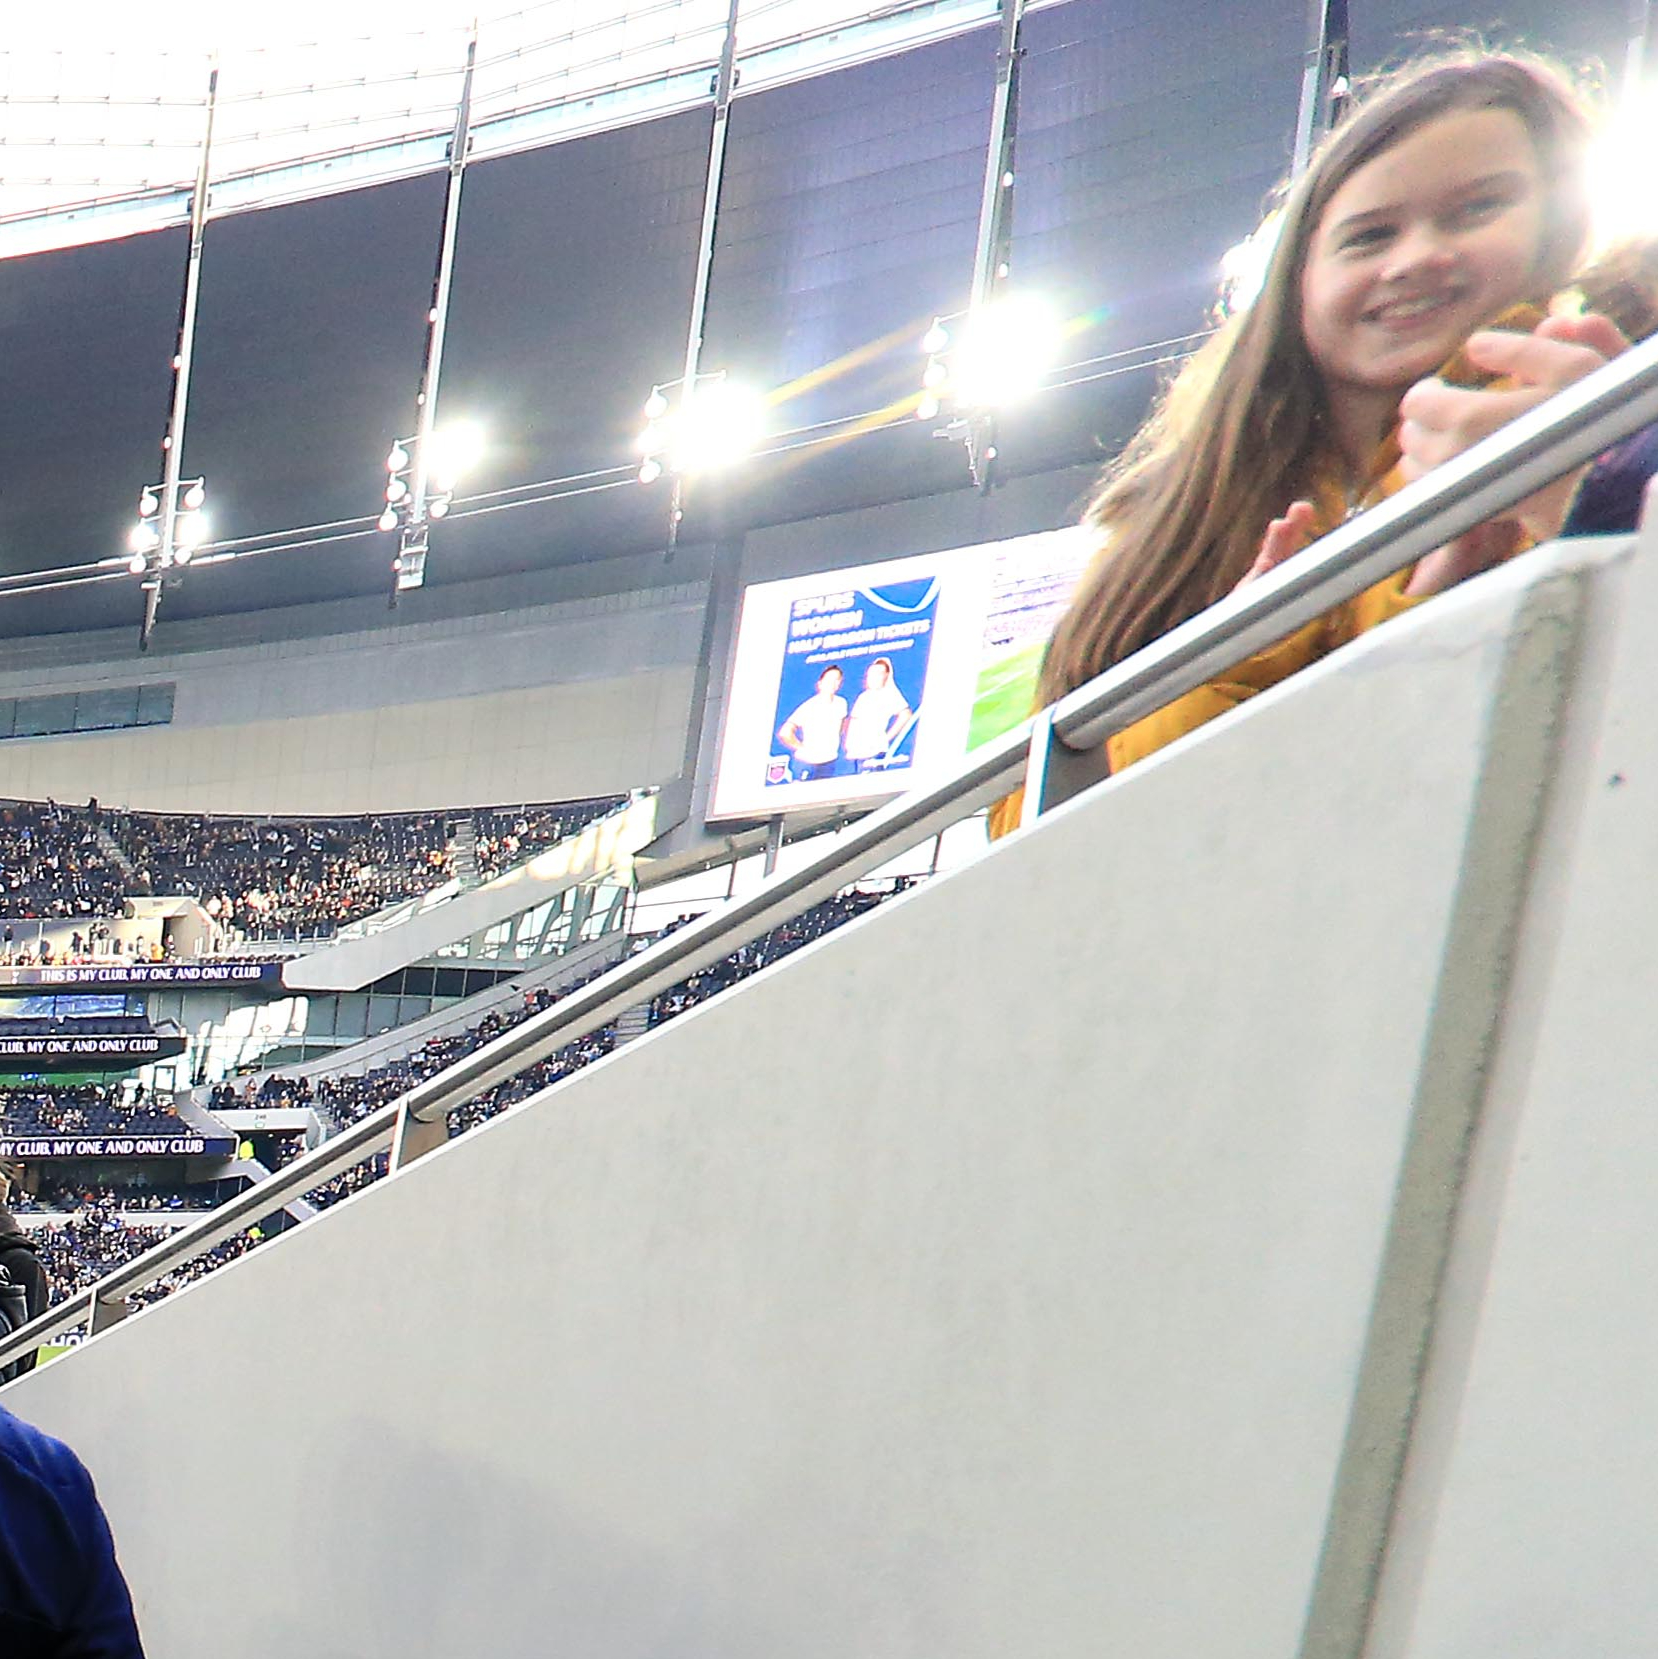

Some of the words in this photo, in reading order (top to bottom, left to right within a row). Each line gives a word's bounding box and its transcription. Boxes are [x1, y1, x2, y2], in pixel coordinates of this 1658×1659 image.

[40, 969, 65, 981] THIS
[65, 969, 77, 981] IS
[78, 968, 96, 981] MY
[130, 967, 148, 980] MY
[150, 967, 174, 980] ONE
[176, 966, 200, 980] AND
[201, 966, 228, 979] ONLY
[231, 965, 260, 979] CLUB
[27, 1040, 45, 1053] MY
[46, 1039, 71, 1053] ONE
[72, 1039, 97, 1052] AND
[98, 1038, 125, 1052] ONLY
[129, 1038, 158, 1052] CLUB
[53, 1140, 74, 1155] MY
[76, 1140, 103, 1155] ONE
[106, 1139, 133, 1154] AND
[135, 1139, 167, 1154] ONLY
[170, 1138, 203, 1153] CLUB
